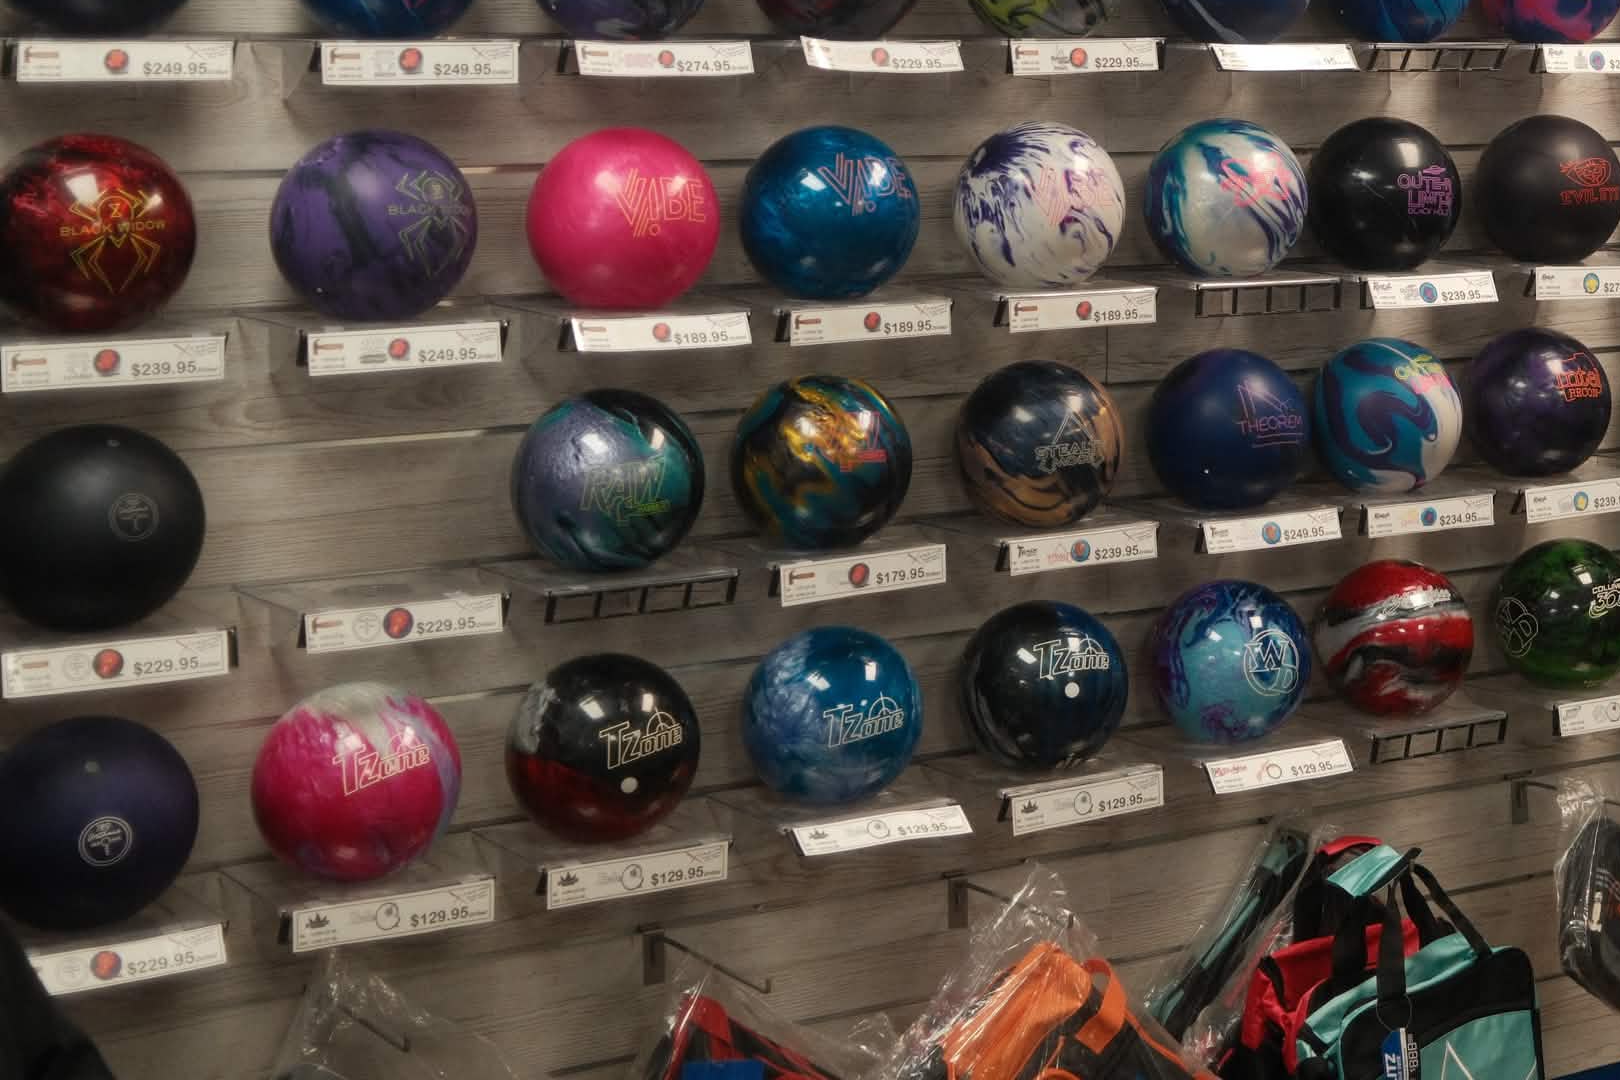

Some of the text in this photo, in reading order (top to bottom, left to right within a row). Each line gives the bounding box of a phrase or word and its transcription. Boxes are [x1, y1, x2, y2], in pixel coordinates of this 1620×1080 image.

[143, 62, 208, 75] $249.95
[433, 63, 492, 76] $249.95
[677, 60, 731, 72] $274.95
[1095, 57, 1141, 68] $229.95
[60, 220, 166, 238] BLACK WIDOW
[1441, 290, 1481, 302] $239.95
[1093, 308, 1139, 322] $189.95
[884, 320, 932, 334] $189.95
[674, 330, 729, 345] $189.95
[418, 347, 478, 363] $249.95
[132, 361, 197, 377] $239.95
[1440, 512, 1478, 526] $234.95
[1284, 526, 1326, 543] $249.95
[1095, 544, 1141, 561] $239.95
[876, 567, 925, 585] $179.95
[417, 617, 477, 635] $229.95
[134, 656, 200, 676] $229.95
[1290, 760, 1334, 777] $129.95
[1098, 793, 1144, 812] $129.95
[897, 821, 948, 836] $129.95
[650, 866, 705, 885] $129.95
[409, 906, 470, 927] $129.95
[128, 952, 195, 976] $229.95
